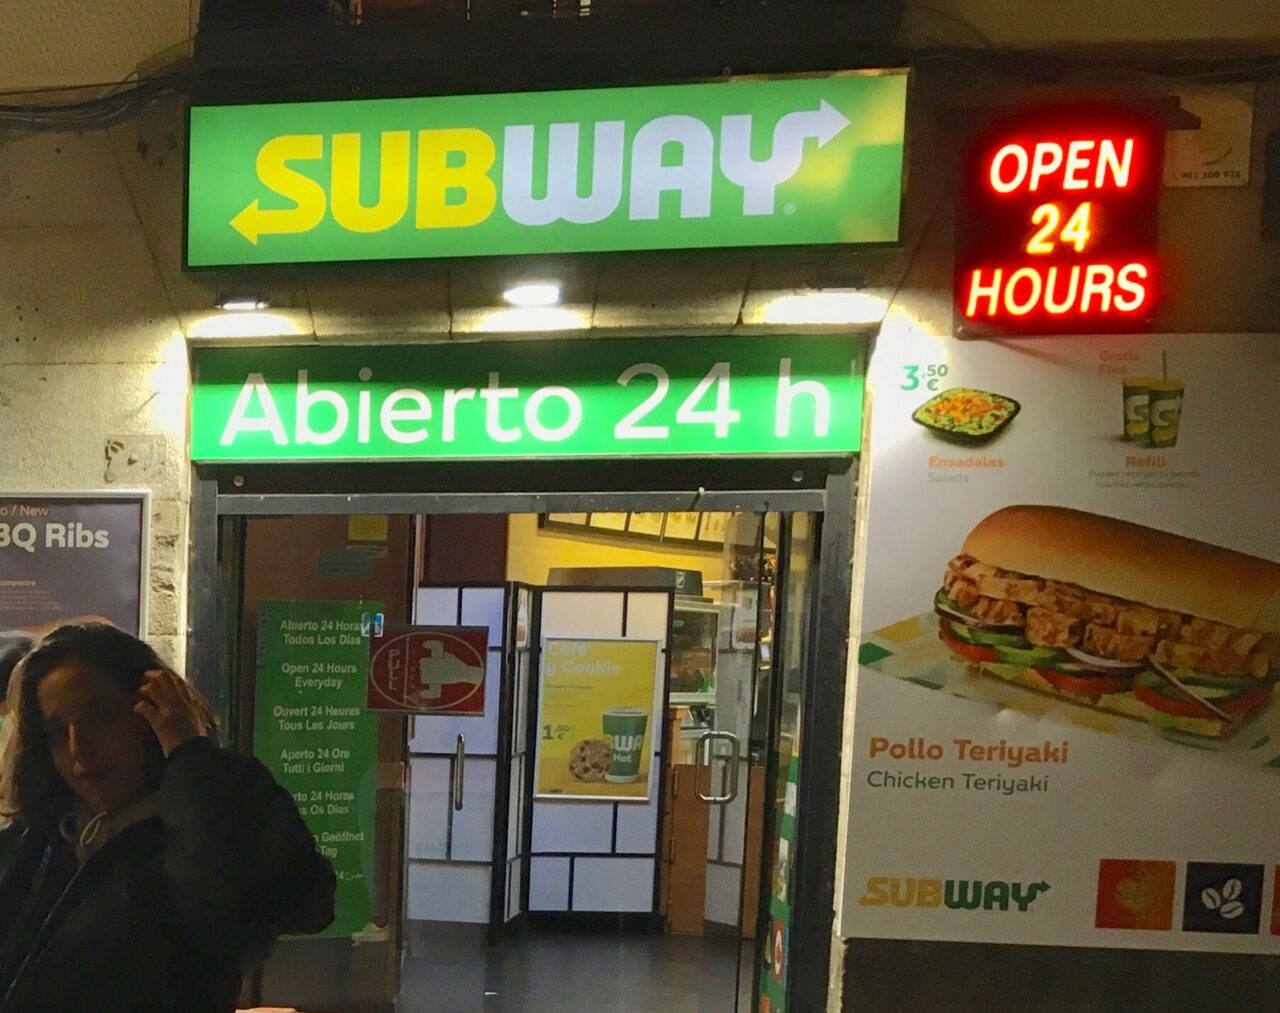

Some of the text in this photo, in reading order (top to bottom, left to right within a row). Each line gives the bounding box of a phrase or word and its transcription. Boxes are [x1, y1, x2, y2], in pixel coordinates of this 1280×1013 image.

[229, 98, 851, 246] SUBWAY
[989, 138, 1134, 193] OPEN
[1026, 201, 1091, 254] 24
[965, 263, 1147, 317] HOURS
[219, 356, 831, 447] Abierto 24 h
[927, 472, 969, 483] Salads
[20, 505, 49, 517] New
[45, 522, 110, 549] Ribs
[280, 619, 361, 631] Abierto 24 Hora
[283, 633, 315, 645] Todos
[317, 634, 337, 645] Los
[281, 662, 357, 675] Open 24 Hours
[387, 648, 401, 690] PULL
[562, 660, 622, 675] Cookie
[295, 677, 342, 690] Everyday
[273, 705, 360, 717] Ouvert 24 Heures
[278, 719, 355, 731] Tous Les Jours
[280, 748, 350, 761] Aperto 24 Ore
[869, 737, 1069, 768] Pollo Teriyaki
[282, 762, 305, 774] Tutti
[313, 761, 345, 774] Giorni
[867, 770, 1049, 796] Chicken Teriyaki
[310, 790, 322, 801] 24
[320, 845, 338, 858] Tag
[858, 876, 1051, 912] SUBWAY
